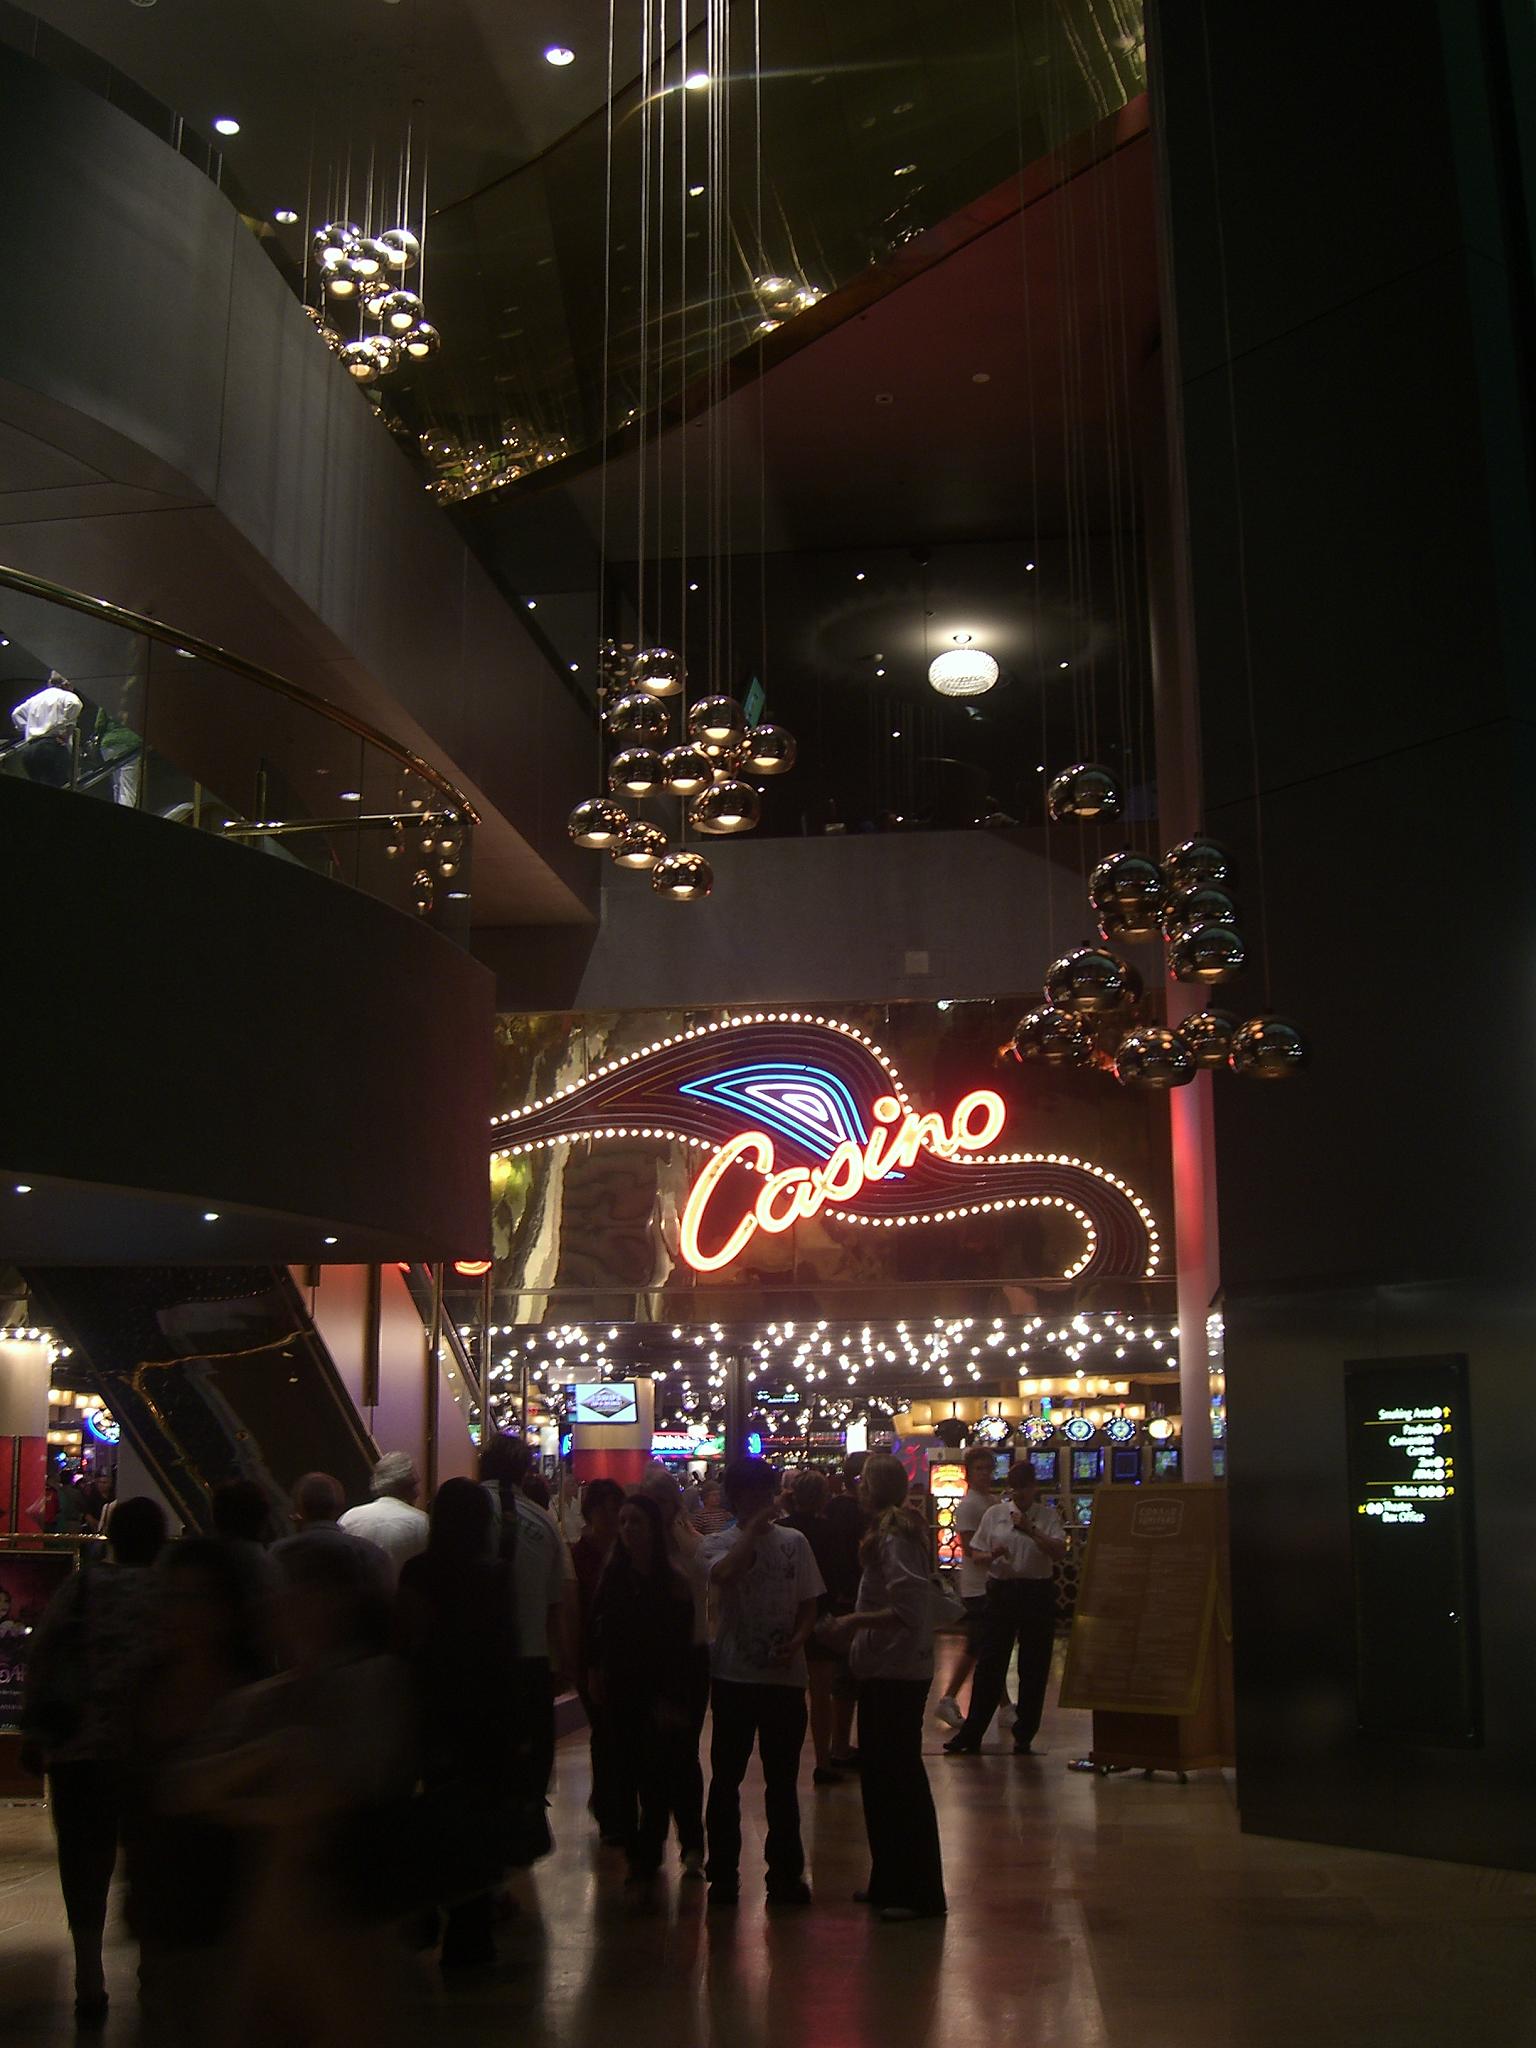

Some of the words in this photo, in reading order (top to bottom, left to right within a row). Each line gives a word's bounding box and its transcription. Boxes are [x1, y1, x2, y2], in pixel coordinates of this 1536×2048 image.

[679, 1088, 1007, 1273] Casino
[1382, 1511, 1398, 1523] Box
[1398, 1511, 1426, 1523] Office
